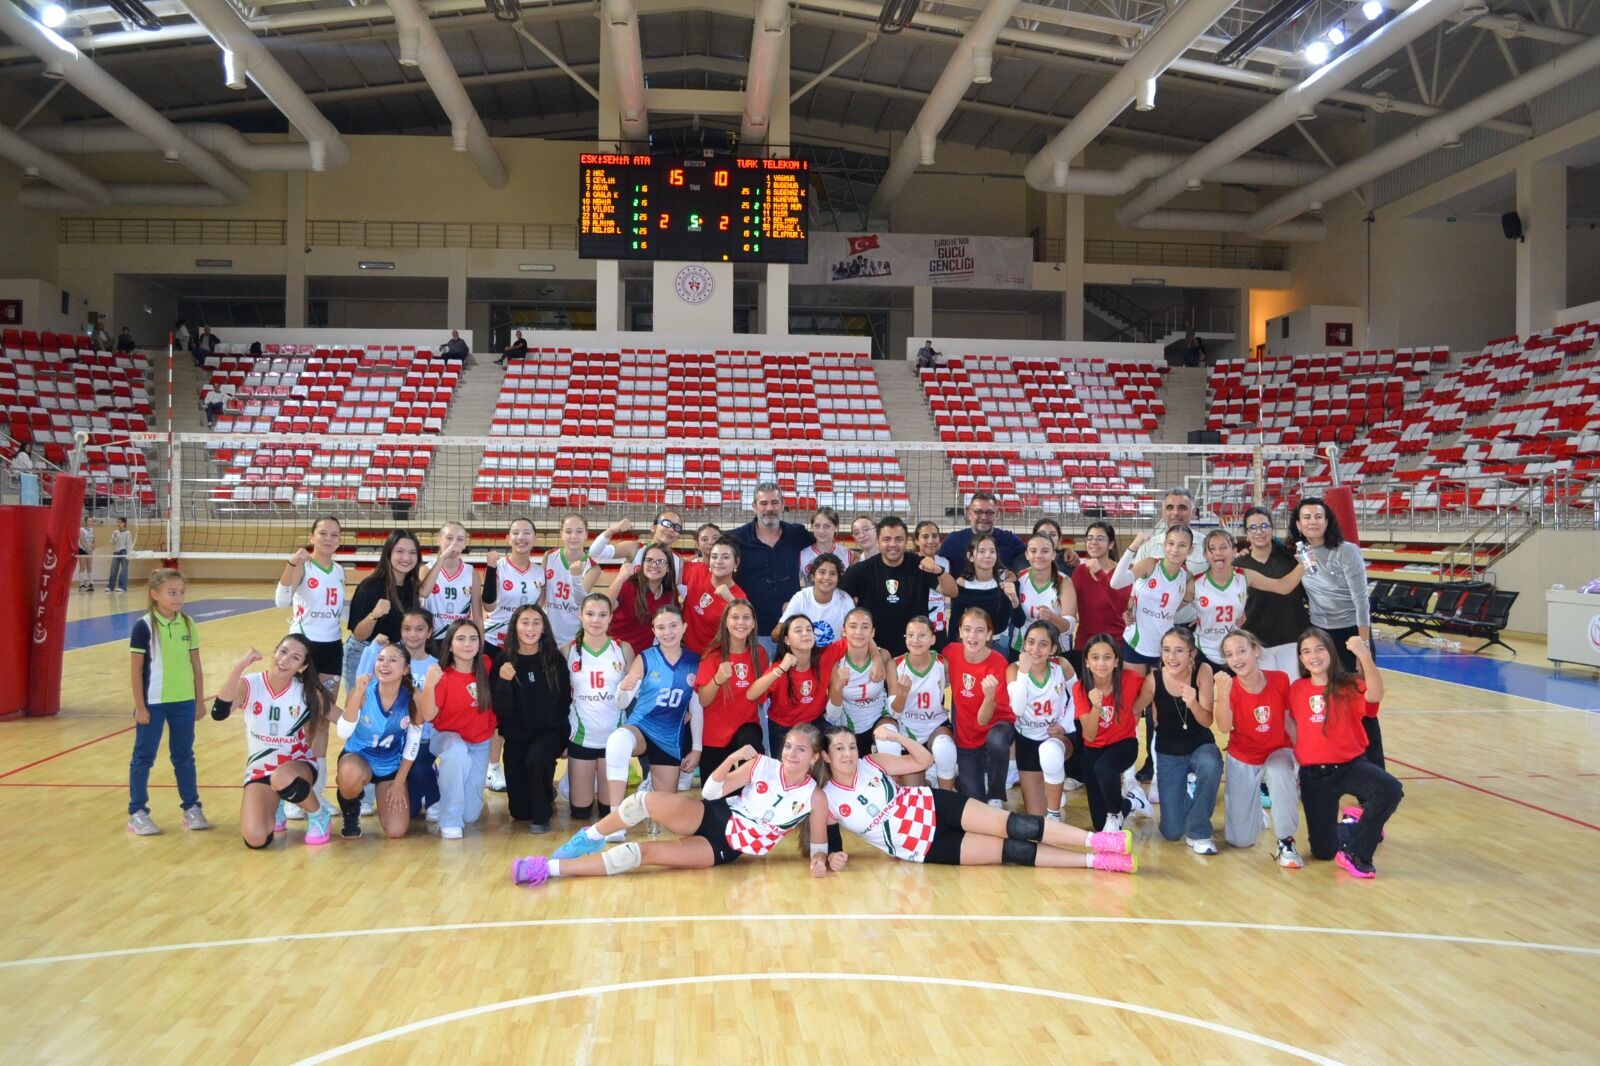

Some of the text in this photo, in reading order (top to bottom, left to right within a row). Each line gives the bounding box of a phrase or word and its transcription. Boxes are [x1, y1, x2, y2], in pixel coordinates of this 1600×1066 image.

[633, 155, 651, 166] ATA
[763, 160, 800, 170] TELEKOM
[670, 169, 683, 185] 15
[714, 170, 728, 187] 10
[585, 183, 591, 191] 7
[660, 213, 669, 229] 2
[690, 214, 699, 228] 5
[720, 215, 729, 230] 2
[445, 586, 457, 600] 99
[520, 581, 527, 594] 2
[555, 581, 570, 600] 35
[326, 587, 338, 606] 15
[1160, 592, 1169, 608] 9
[1215, 605, 1234, 623] 23
[590, 671, 605, 689] 16
[655, 687, 684, 708] 20
[917, 692, 930, 709] 19
[269, 705, 281, 721] 10
[1033, 700, 1053, 716] 24
[372, 733, 395, 748] 14
[772, 794, 783, 807] 7
[857, 794, 869, 806] 8
